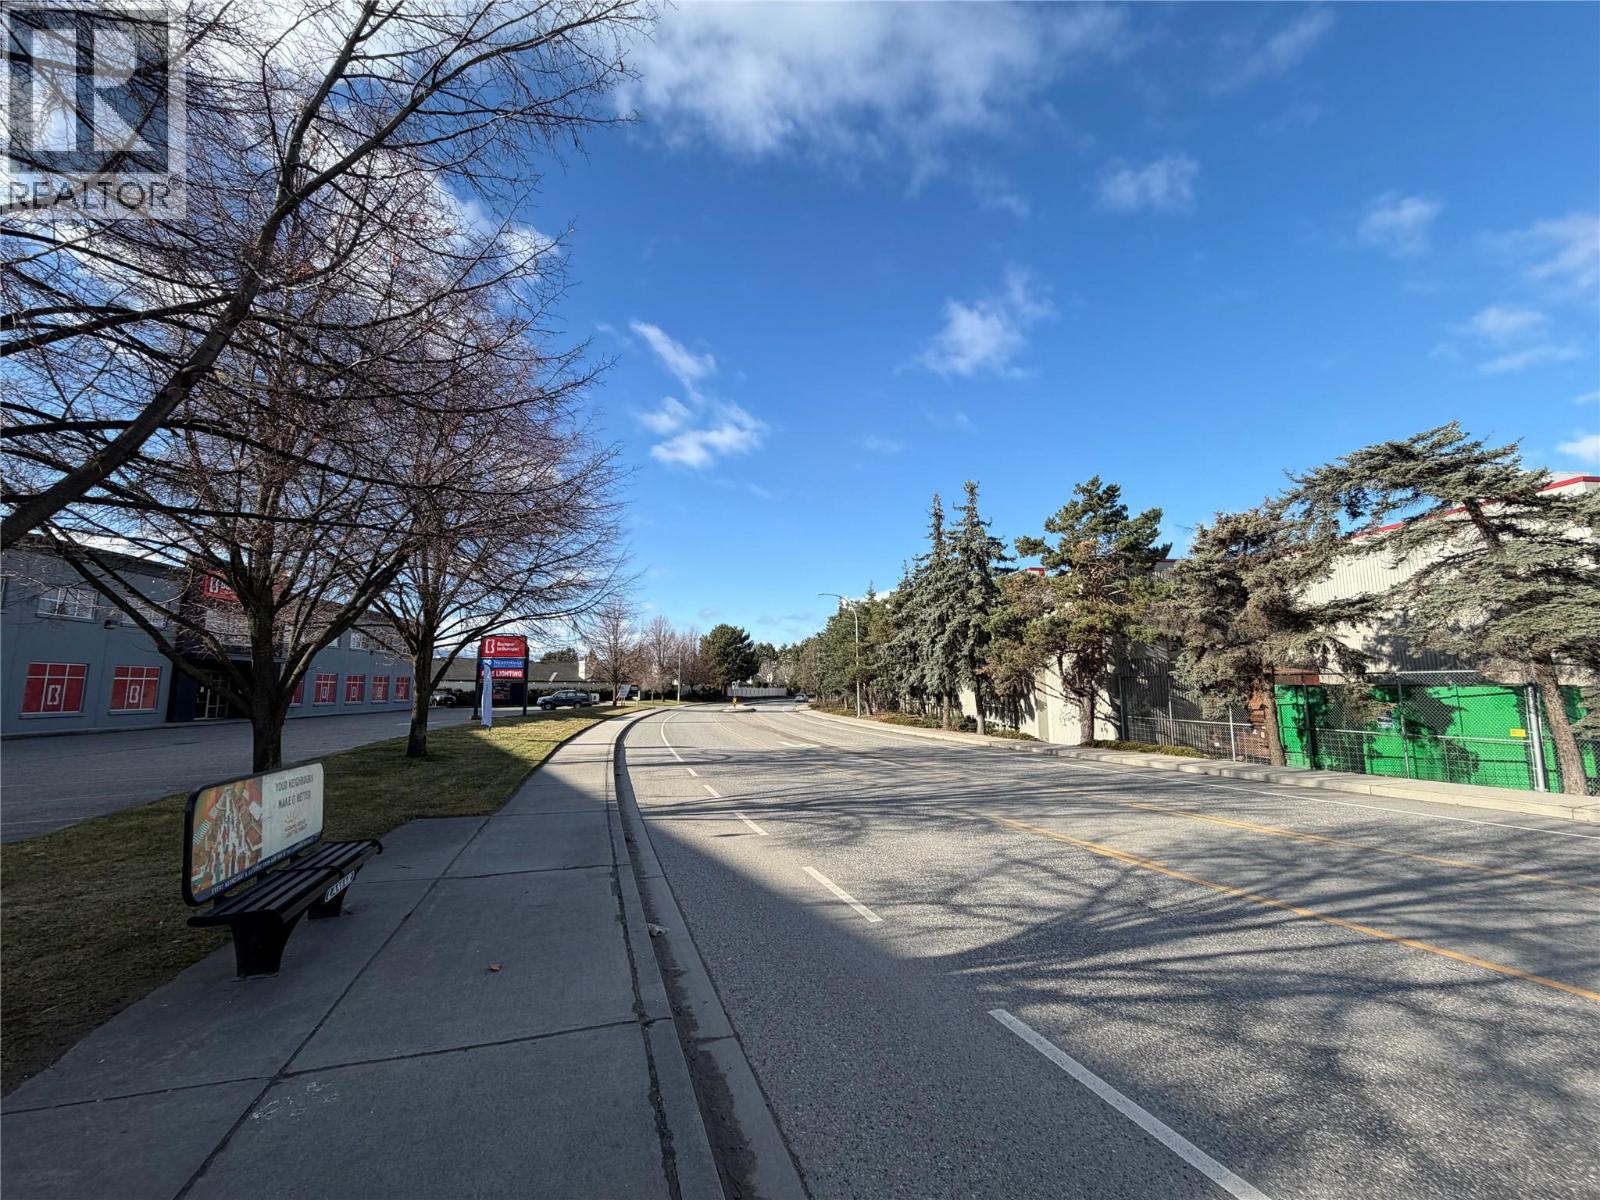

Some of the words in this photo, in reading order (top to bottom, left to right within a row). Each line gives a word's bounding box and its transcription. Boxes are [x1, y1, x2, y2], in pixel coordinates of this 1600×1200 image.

[275, 781, 287, 792] YOUR
[279, 796, 291, 809] MAKE
[297, 790, 311, 803] BETTER
